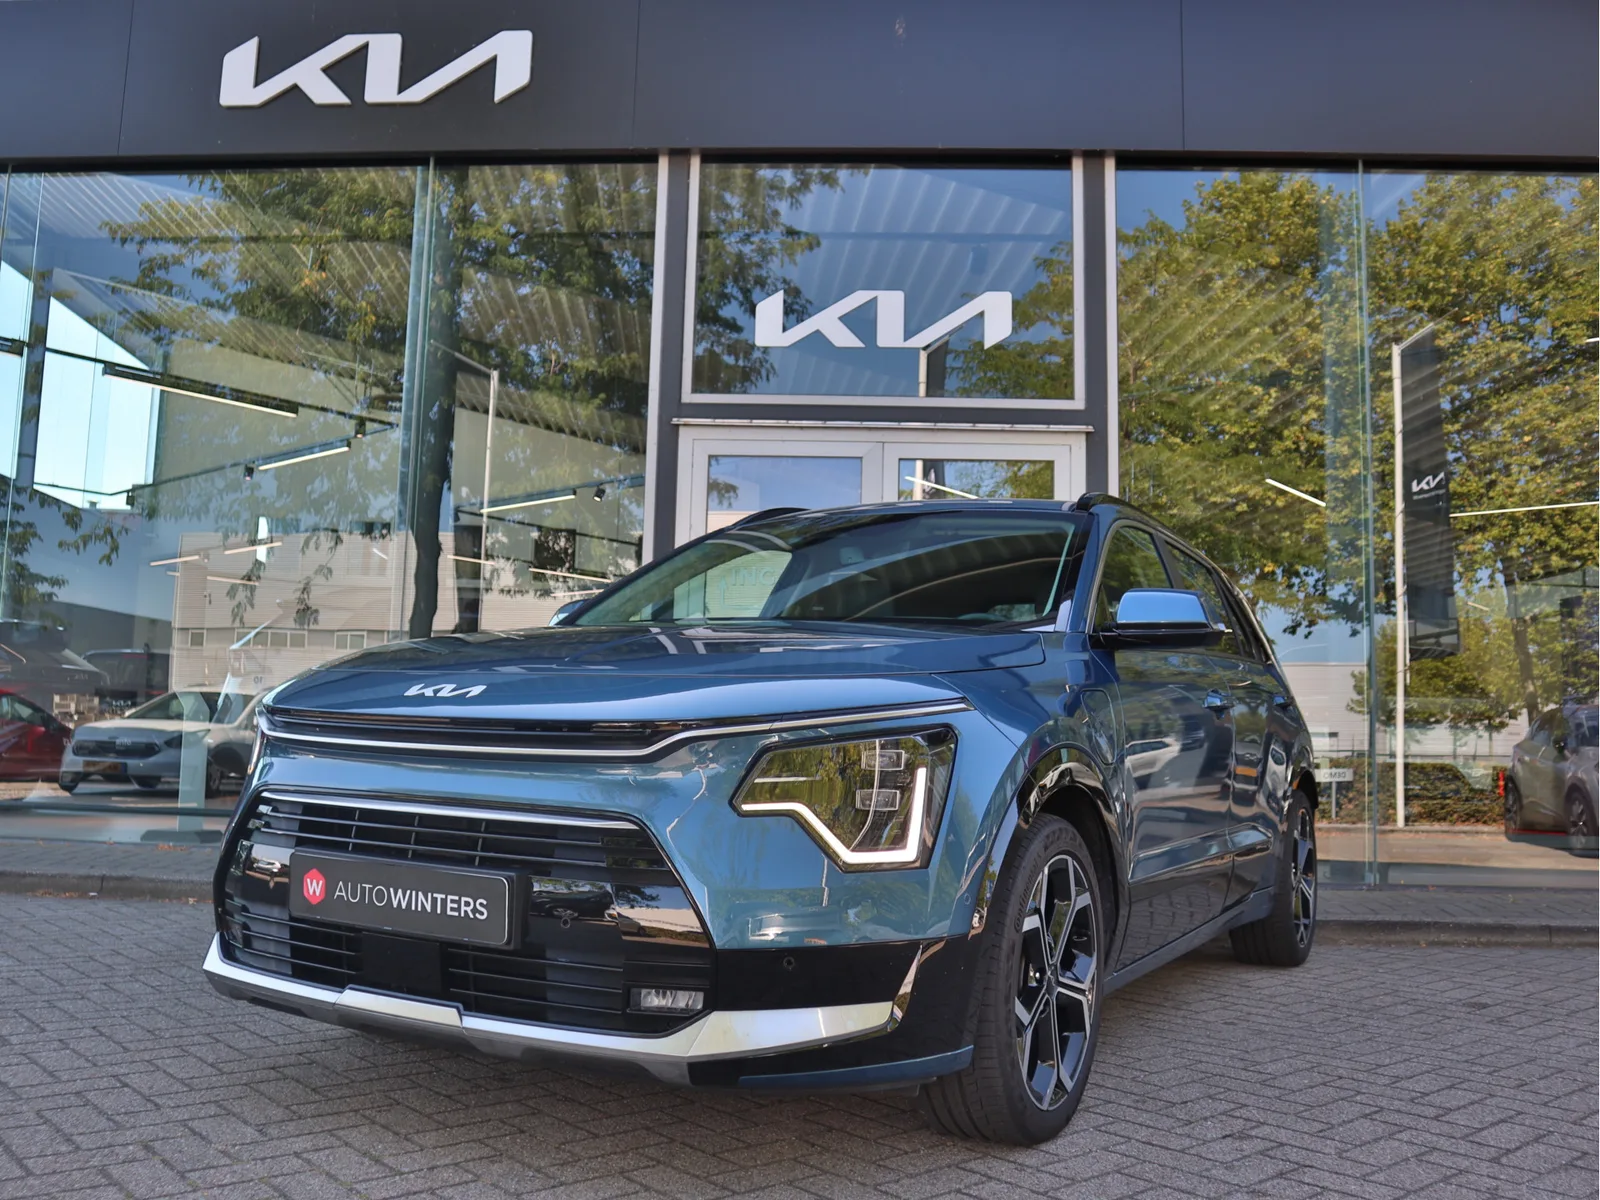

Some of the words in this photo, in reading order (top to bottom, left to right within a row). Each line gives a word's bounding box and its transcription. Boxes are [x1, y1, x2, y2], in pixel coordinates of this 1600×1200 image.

[219, 30, 533, 107] KIA
[755, 289, 1012, 350] KIA
[404, 683, 487, 698] KIA
[333, 880, 488, 920] AUTOWINTERS
